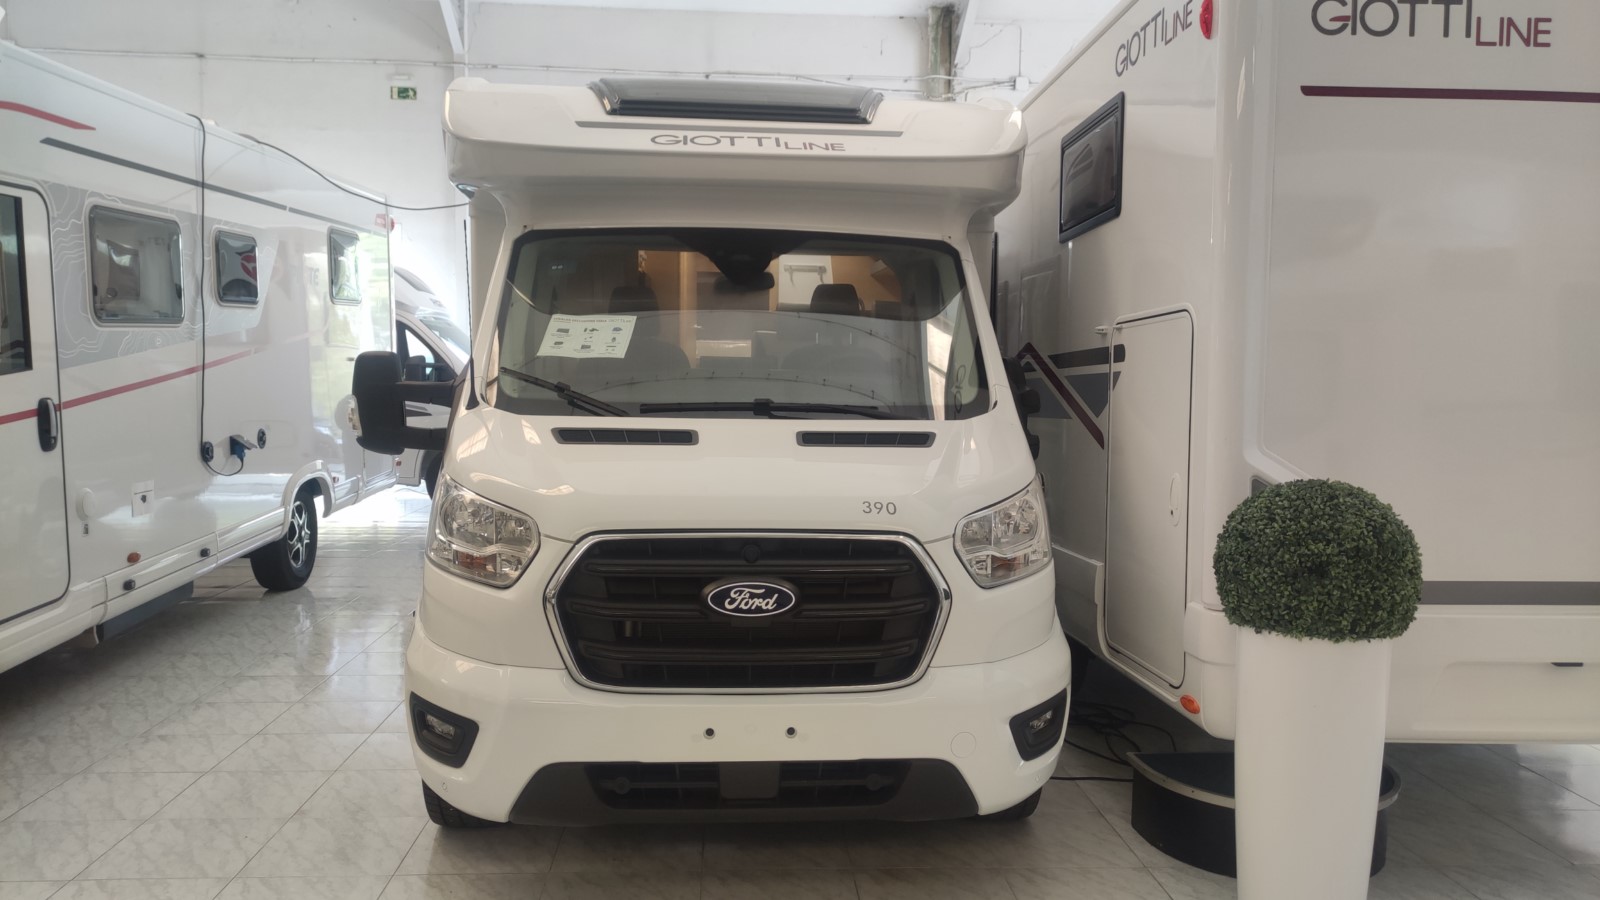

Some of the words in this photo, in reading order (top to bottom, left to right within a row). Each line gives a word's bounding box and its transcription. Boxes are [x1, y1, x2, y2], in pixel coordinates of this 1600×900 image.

[650, 134, 846, 152] GIOTTILINE
[862, 501, 897, 515] 390
[724, 587, 779, 610] Ford
